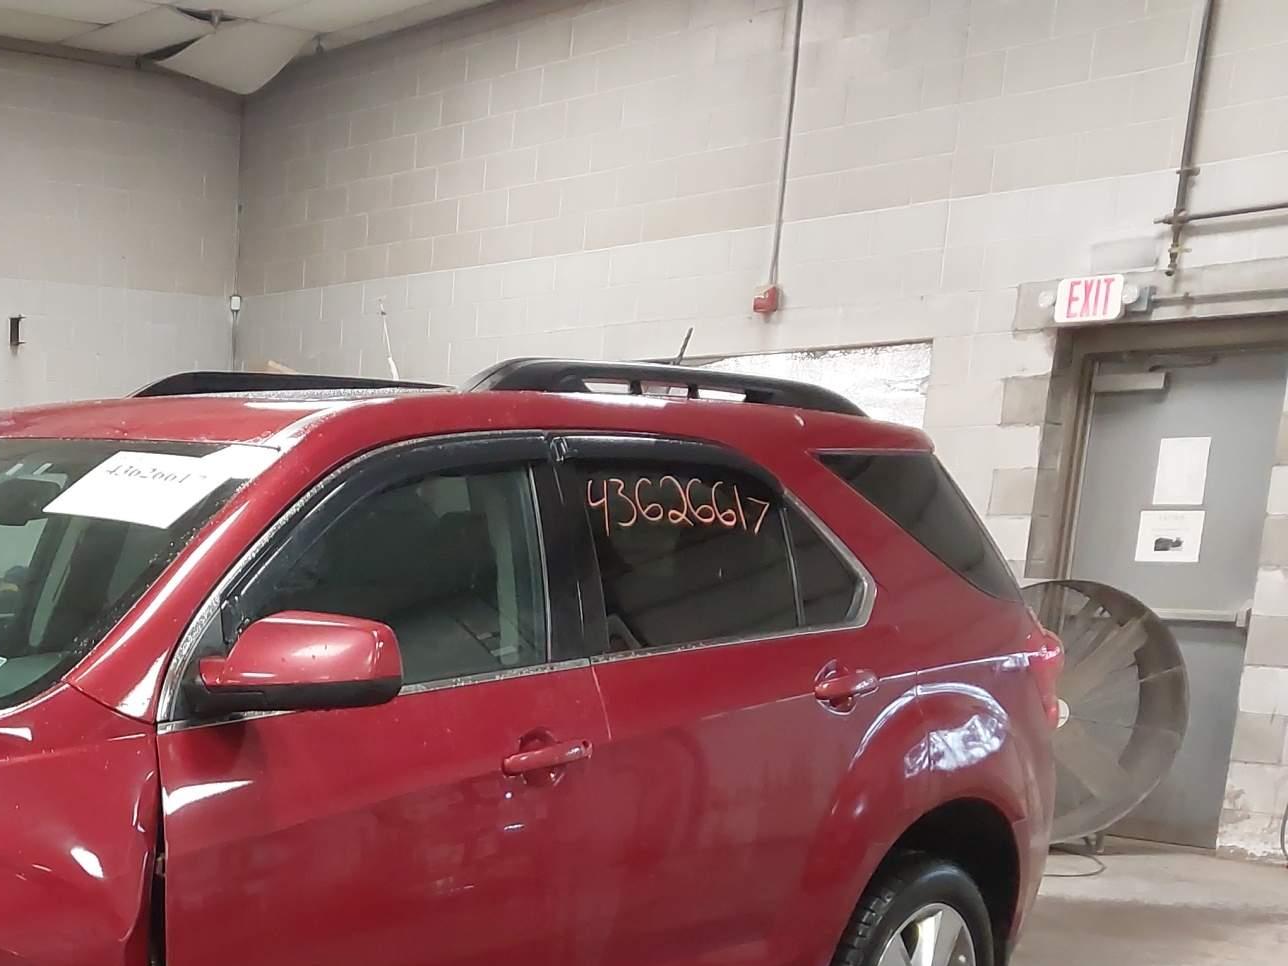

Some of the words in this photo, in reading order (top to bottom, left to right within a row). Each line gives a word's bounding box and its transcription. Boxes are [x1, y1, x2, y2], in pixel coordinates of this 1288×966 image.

[1065, 277, 1115, 319] EXIT
[106, 464, 208, 484] 4362661
[587, 475, 771, 537] 43626617
